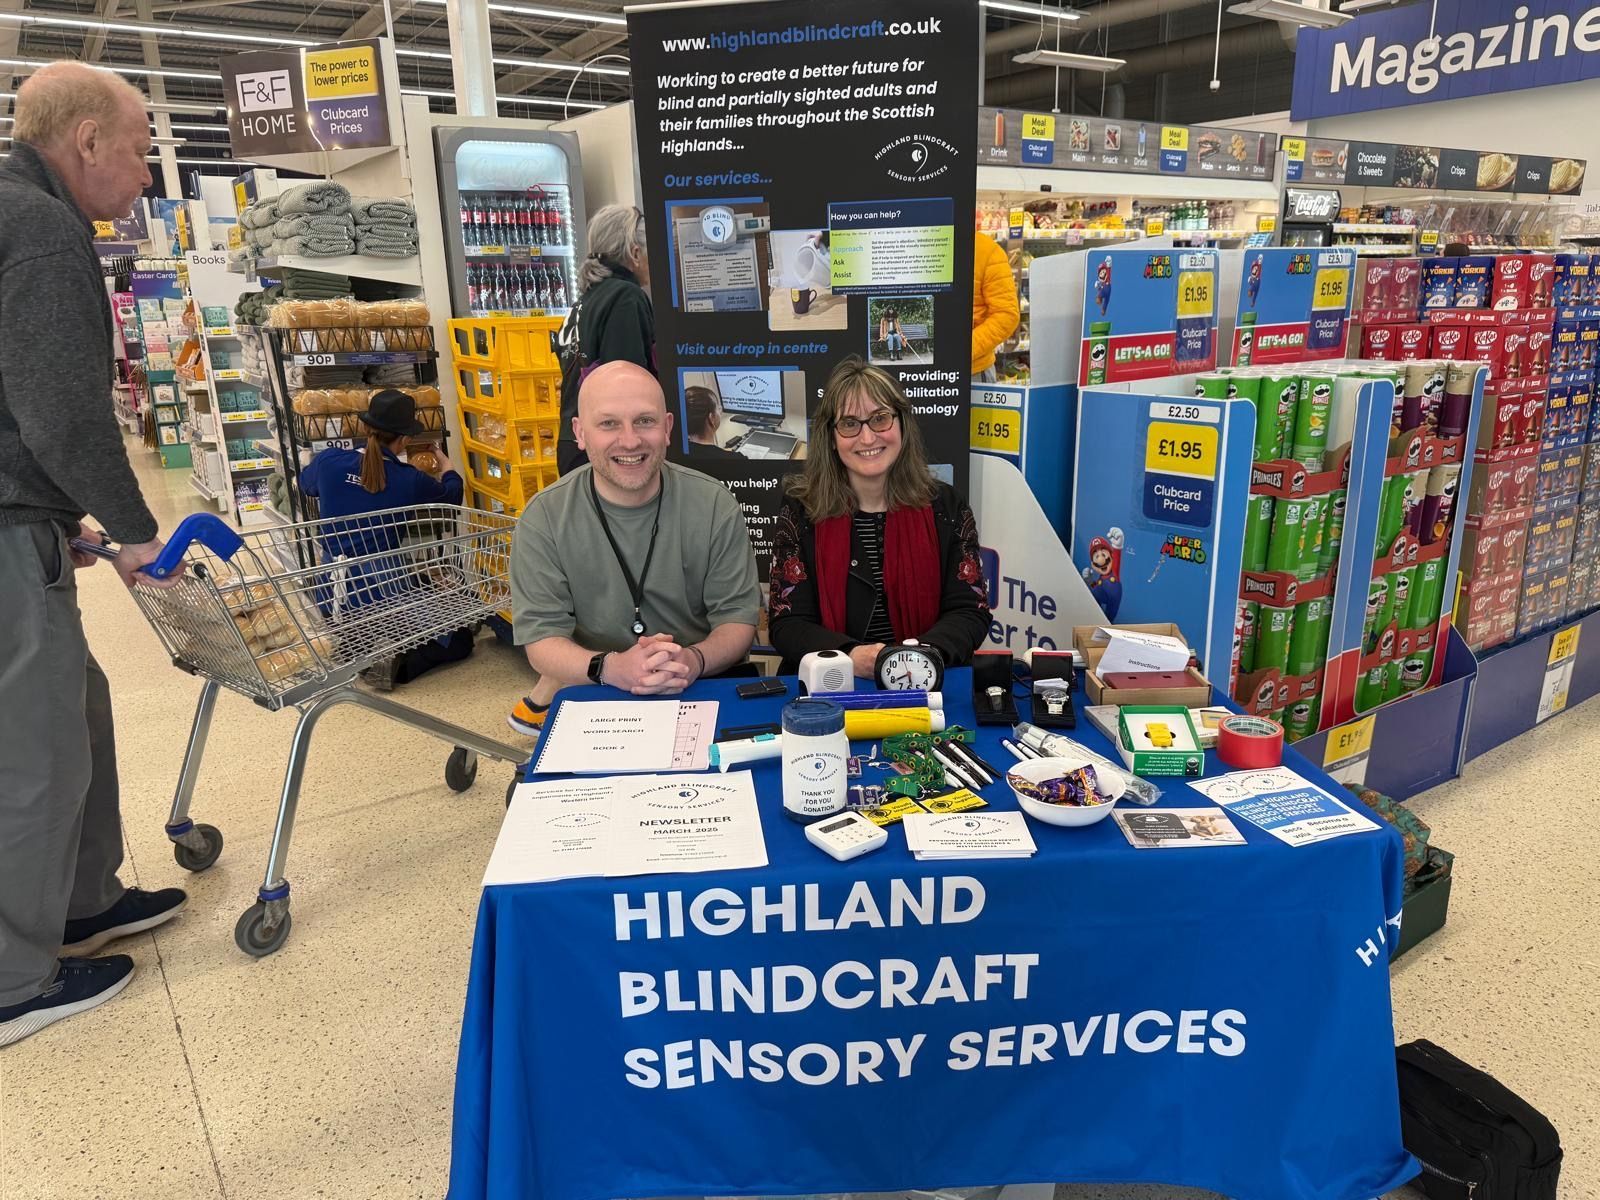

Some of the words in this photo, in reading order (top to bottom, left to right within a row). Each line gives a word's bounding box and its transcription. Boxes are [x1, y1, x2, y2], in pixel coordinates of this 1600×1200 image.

[662, 17, 942, 52] www.highlandblindcraft.co.uk
[1330, 4, 1600, 94] Magazine
[310, 62, 327, 73] The
[329, 60, 356, 73] power
[359, 58, 369, 68] to
[314, 73, 339, 86] lower
[341, 71, 369, 86] prices
[657, 72, 717, 91] Working
[721, 70, 736, 85] to
[738, 67, 786, 83] create
[789, 68, 799, 80] a
[803, 62, 849, 80] better
[851, 59, 899, 77] future
[901, 57, 925, 73] for
[239, 75, 287, 107] F&F
[658, 94, 694, 111] blind
[697, 92, 726, 108] and
[728, 89, 791, 110] partially
[794, 85, 850, 106] sighted
[854, 83, 902, 98] adults
[906, 80, 938, 96] and
[321, 105, 369, 121] Clubcard
[659, 116, 693, 132] their
[695, 113, 753, 132] families
[756, 109, 841, 129] throughout
[844, 107, 869, 121] the
[871, 104, 935, 120] Scottish
[241, 114, 296, 137] HOME
[330, 122, 363, 135] Prices
[1032, 118, 1047, 127] Meal
[1032, 127, 1046, 136] Deal
[1169, 130, 1182, 139] Meal
[661, 138, 745, 156] Highlands...
[874, 135, 911, 161] HIGHLAND
[913, 134, 960, 157] BLINDCRAFT
[1169, 138, 1181, 147] Deal
[991, 147, 1008, 158] Drink
[1072, 152, 1087, 163] Main
[1102, 154, 1119, 165] Snack
[1357, 152, 1387, 165] Chocolate
[886, 168, 916, 183] SENSORY
[918, 164, 949, 182] SERVICES
[1358, 165, 1363, 175] &
[1363, 166, 1384, 177] Sweets
[1450, 165, 1466, 177] Crisps
[1526, 170, 1541, 182] Crisps
[664, 171, 692, 187] Our
[695, 170, 773, 187] services...
[831, 212, 847, 221] How
[848, 213, 863, 222] you
[865, 211, 878, 220] can
[879, 210, 902, 220] help?
[192, 255, 226, 265] Books
[1147, 255, 1170, 267] SUPER
[1291, 253, 1311, 264] SUPER
[833, 271, 852, 279] Assist
[1144, 267, 1172, 279] MARIO
[1286, 263, 1311, 275] MARIO
[1430, 267, 1454, 275] YORKIE
[1461, 266, 1486, 274] YORKIE
[132, 272, 154, 280] Easter
[1185, 286, 1208, 303] £1.95
[1320, 281, 1343, 297] £1.95
[1315, 318, 1340, 330] Clubcard
[1181, 327, 1207, 339] Clubcard
[1319, 329, 1334, 339] Price
[1187, 338, 1202, 350] Price
[1258, 334, 1286, 348] LET'S-A
[1288, 333, 1304, 345] GO!
[676, 343, 705, 355] Visit
[707, 344, 728, 355] our
[731, 343, 764, 357] drop
[767, 343, 780, 355] in
[783, 342, 828, 355] centre
[1115, 346, 1151, 361] LET'S-A
[1153, 343, 1170, 357] GO!
[899, 370, 960, 383] Providing:
[983, 393, 1007, 405] £2.50
[1168, 405, 1200, 420] £2.50
[977, 421, 1010, 439] £1.95
[1158, 438, 1202, 460] £1.95
[346, 473, 361, 482] TES
[1252, 467, 1283, 489] PRINGLES
[727, 480, 747, 490] you
[749, 478, 778, 491] help?
[1153, 484, 1201, 501] Clubcard
[1163, 499, 1190, 513] Price
[1167, 533, 1201, 550] SUPER
[1161, 543, 1207, 564] MARIO
[1245, 577, 1276, 597] PRINGLES
[1003, 576, 1057, 620] The
[889, 660, 897, 669] 10
[923, 660, 929, 669] 2
[1128, 658, 1161, 671] Instructions
[886, 667, 891, 676] 9
[928, 670, 933, 679] 3
[890, 675, 896, 684] 8
[898, 682, 904, 690] 7
[922, 678, 928, 687] 4
[631, 784, 677, 799] HIGHLAND
[680, 783, 738, 793] BLINDCRAFT
[823, 788, 835, 796] YOU
[647, 802, 684, 810] SENSORY
[687, 797, 725, 809] SERVICES
[803, 804, 835, 813] DONATION
[1271, 795, 1324, 810] BLINDCRAFT
[639, 815, 732, 827] NEWSLETTER
[1307, 818, 1342, 827] Become
[1316, 822, 1357, 832] volunteer
[613, 876, 987, 942] HIGHLAND
[618, 953, 1040, 1018] BLINDCRAFT
[623, 1034, 927, 1090] SENSORY
[946, 1009, 1248, 1071] SERVICES
